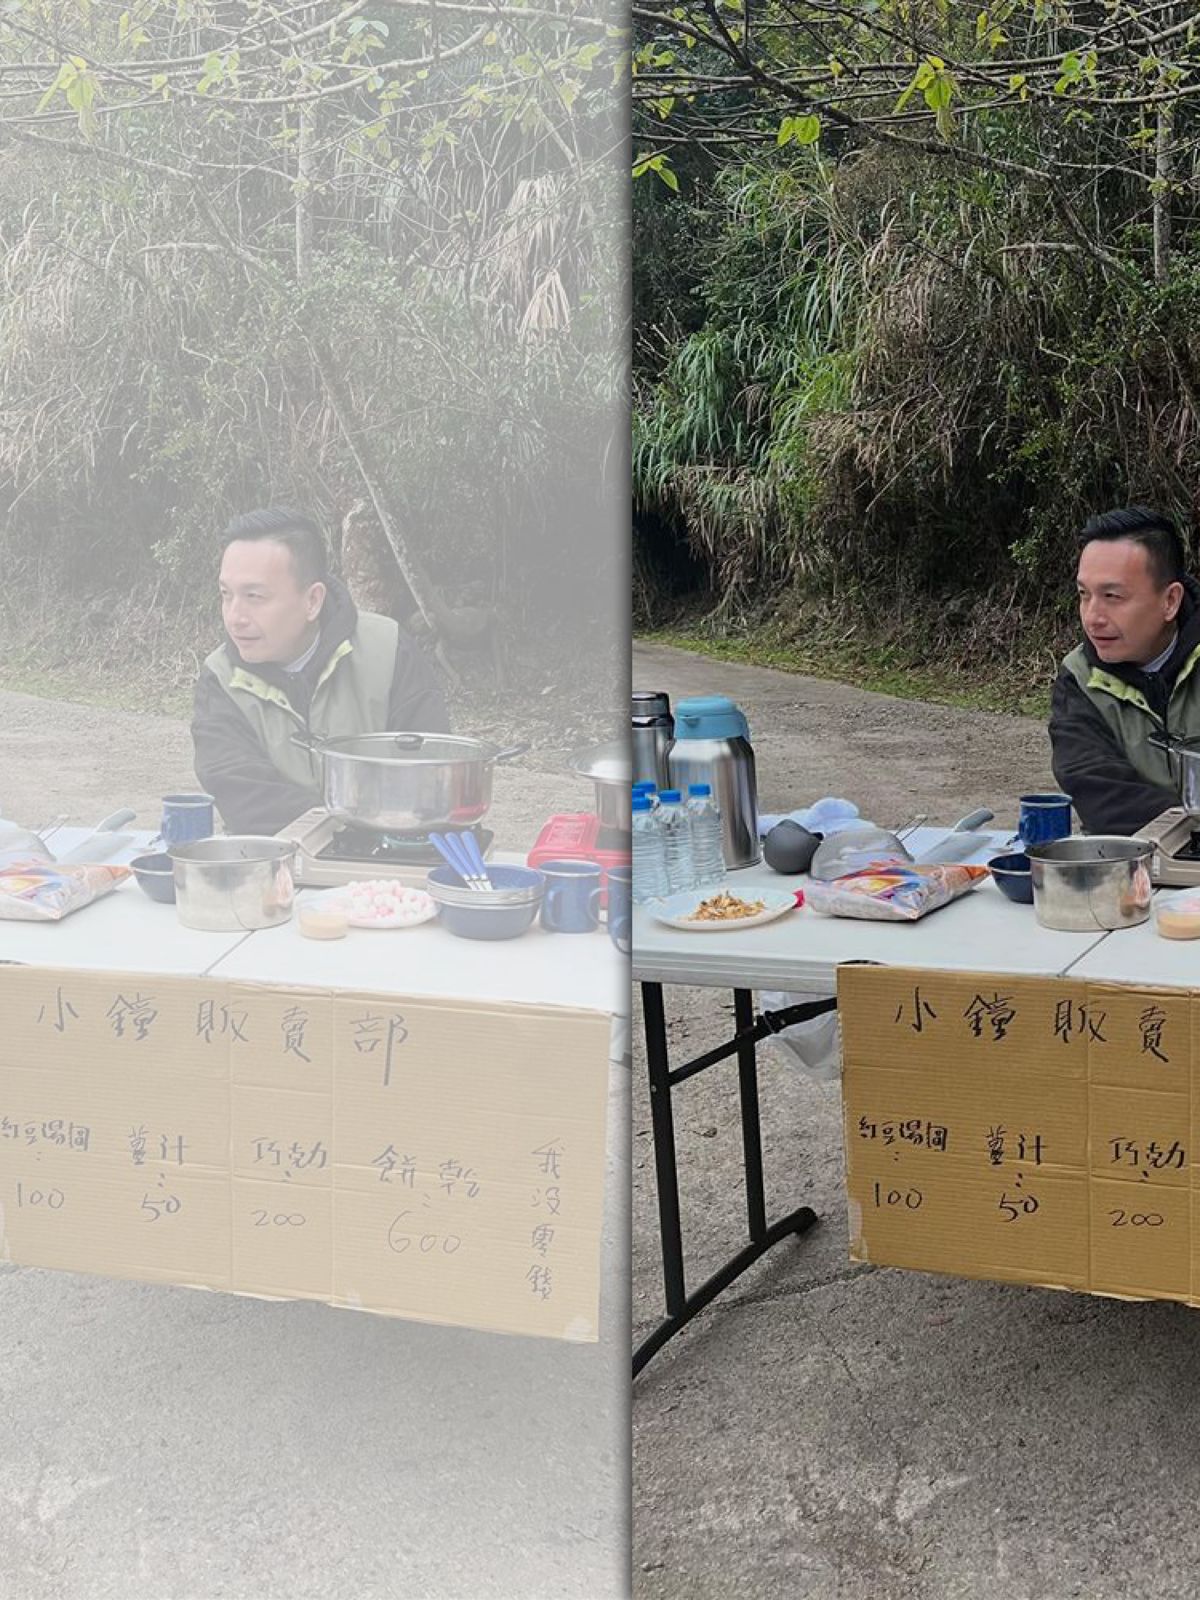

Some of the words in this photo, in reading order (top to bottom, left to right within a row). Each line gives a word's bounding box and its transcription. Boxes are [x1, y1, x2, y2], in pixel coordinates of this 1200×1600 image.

[874, 1182, 922, 1209] 100
[999, 1192, 1039, 1223] 50
[1108, 1209, 1164, 1227] 200
